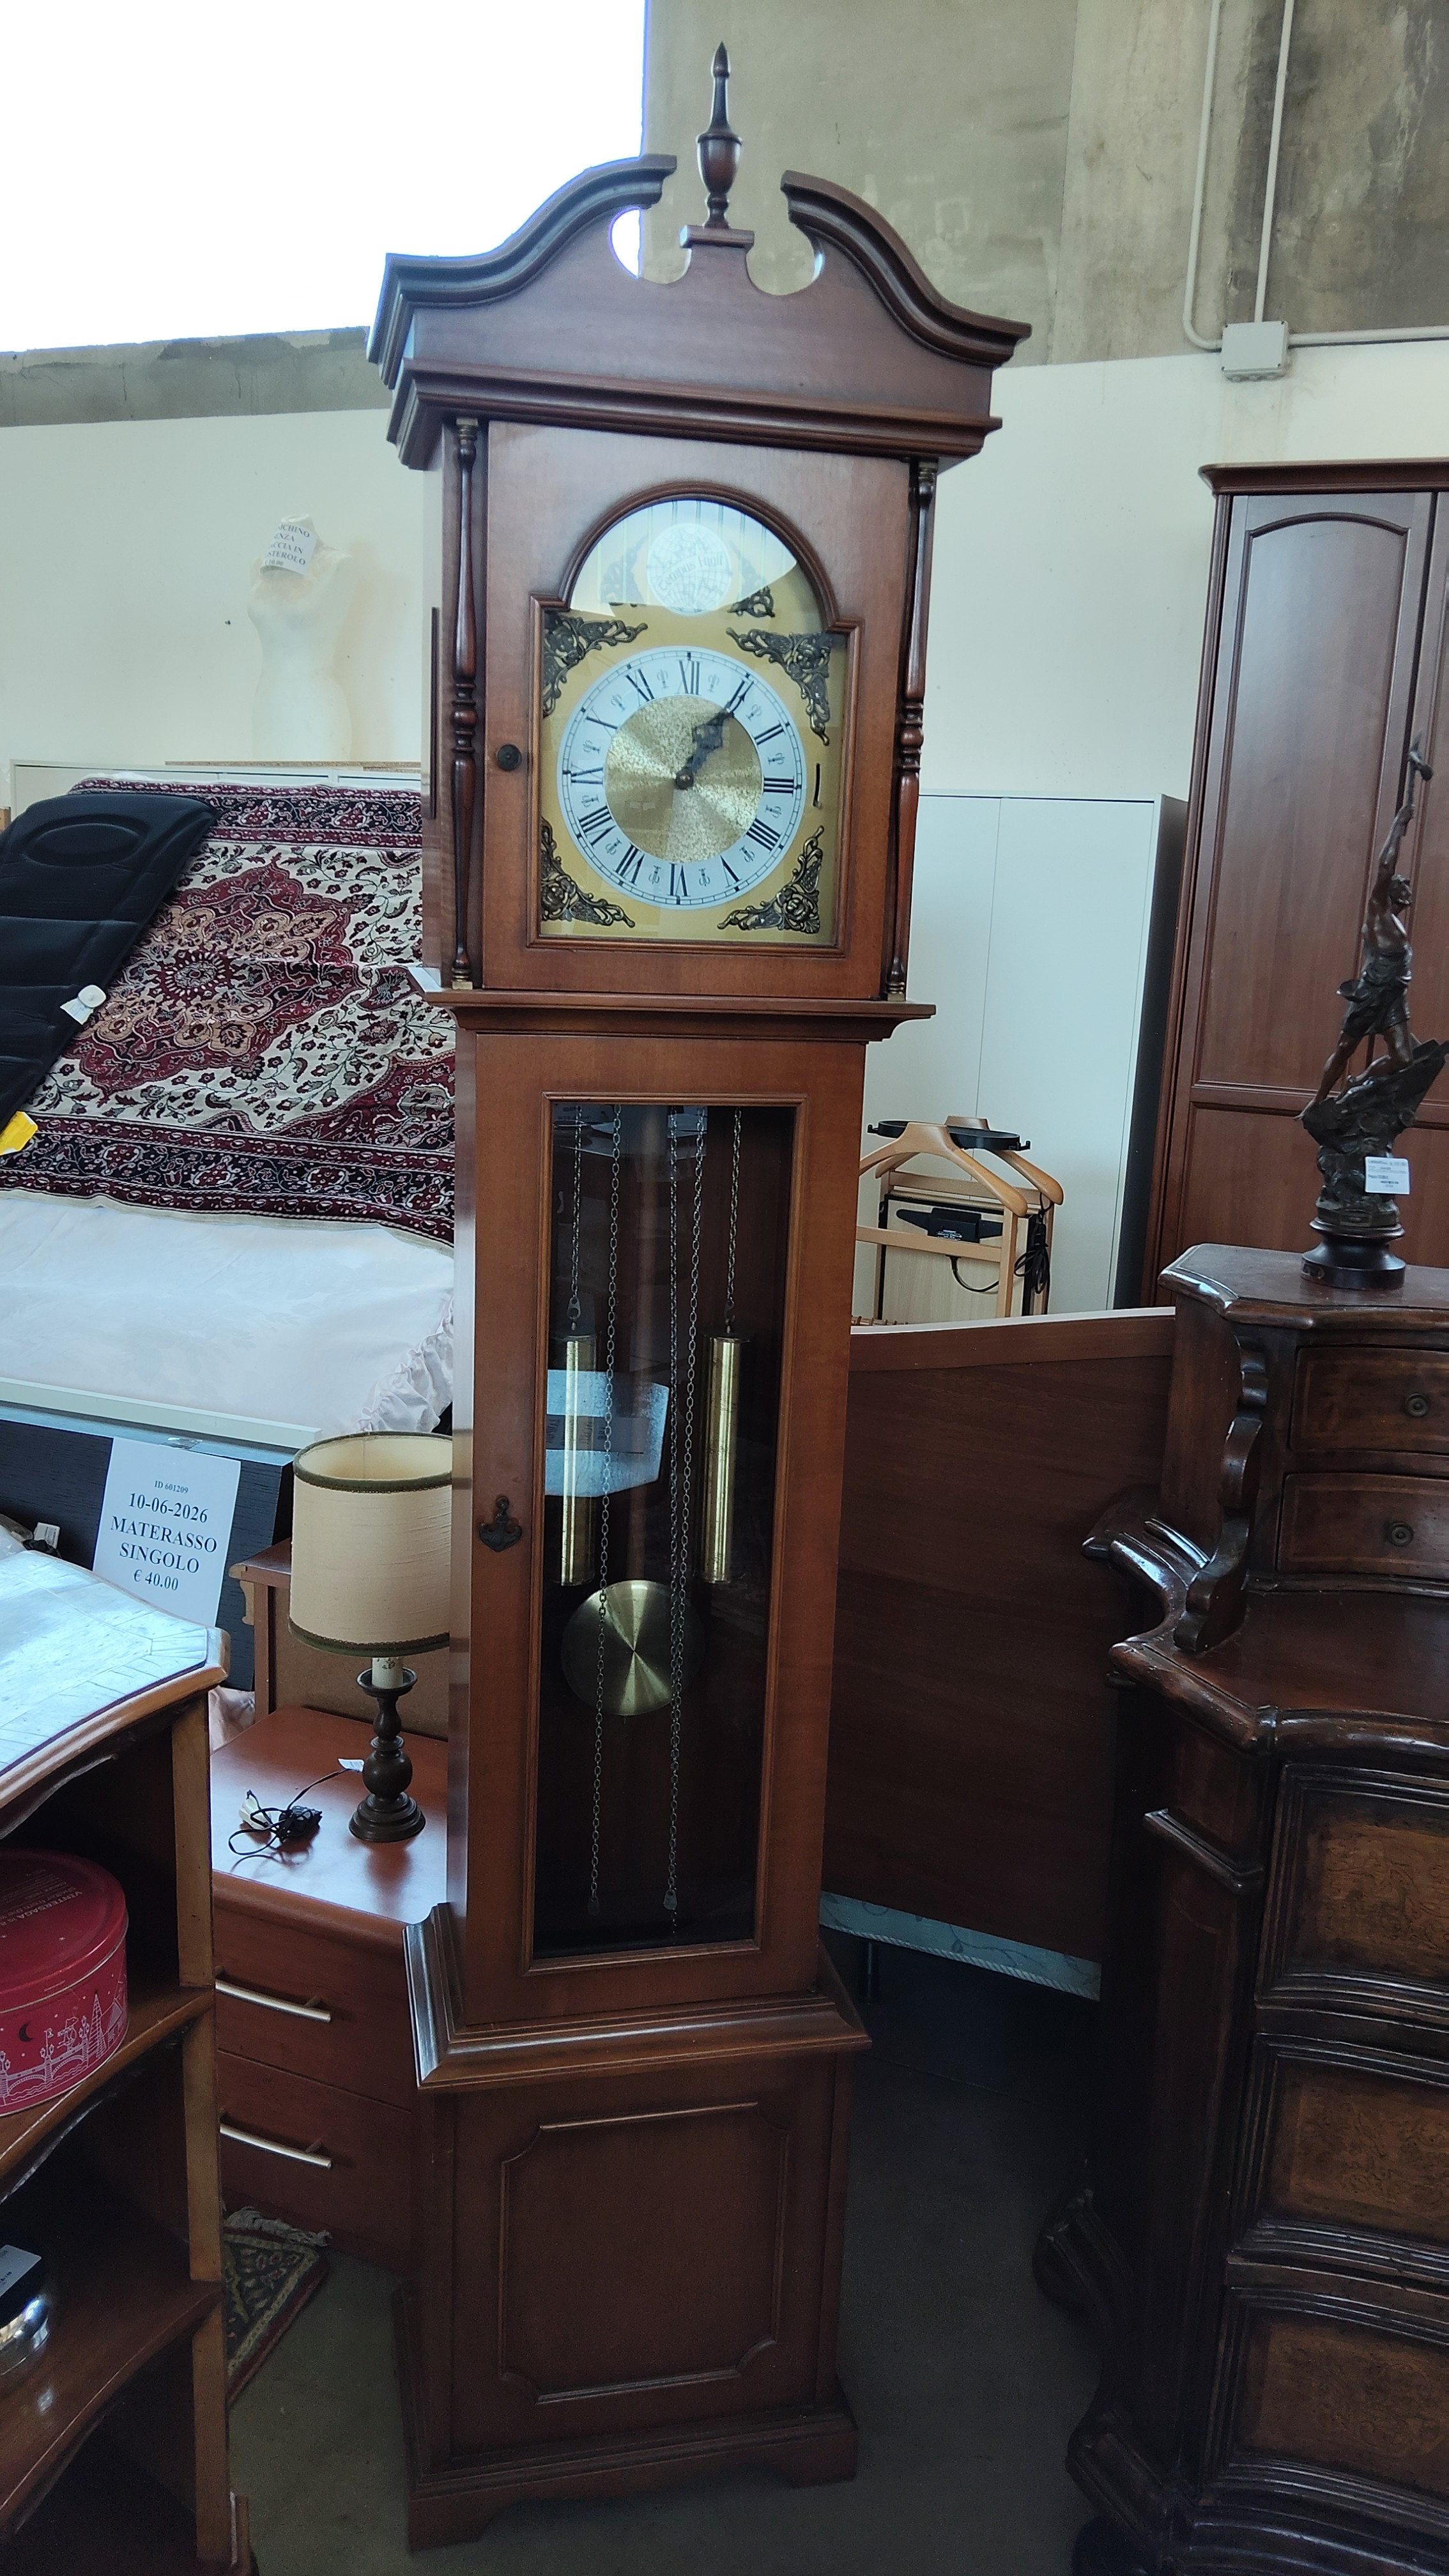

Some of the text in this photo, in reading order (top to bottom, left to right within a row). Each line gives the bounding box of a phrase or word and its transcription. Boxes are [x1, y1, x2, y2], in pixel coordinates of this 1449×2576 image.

[278, 524, 310, 538] ICHINO
[293, 546, 304, 554] IN
[625, 668, 656, 707] XI
[674, 659, 702, 695] XII
[582, 705, 619, 738] X
[754, 719, 786, 747] II
[570, 761, 604, 787] IX
[762, 775, 795, 797] III
[577, 804, 617, 850] VIII
[743, 817, 783, 854] IIII
[612, 841, 646, 886] VII
[719, 855, 743, 888] V
[666, 862, 691, 898] VI
[154, 1480, 188, 1494] ID 601209
[128, 1492, 209, 1524] 10-06-2026
[110, 1516, 217, 1553] MATERASSO
[119, 1542, 199, 1574] SINGOLO
[134, 1569, 179, 1591] € 40.00
